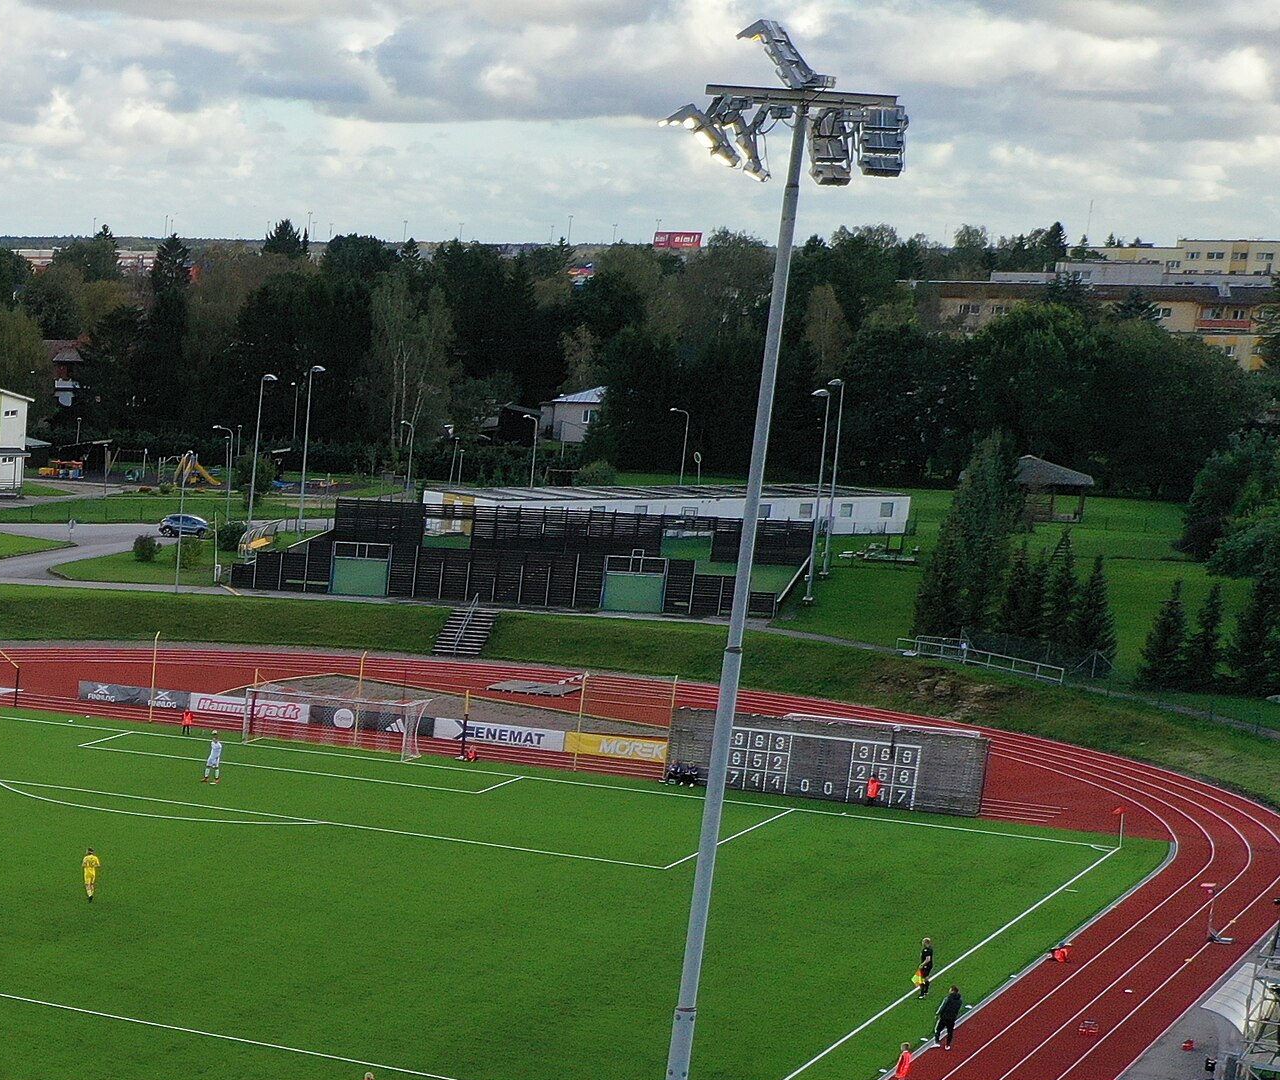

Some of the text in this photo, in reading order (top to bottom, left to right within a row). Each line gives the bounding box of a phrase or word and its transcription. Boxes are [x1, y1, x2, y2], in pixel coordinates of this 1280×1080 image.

[87, 693, 115, 702] FINNLOG
[734, 733, 784, 749] 9 6 3
[732, 752, 782, 769] 8 5 2
[859, 746, 912, 763] 3 6 9
[730, 771, 780, 789] 7 4 1
[856, 765, 909, 783] 2 5 8
[800, 779, 833, 795] 0 0
[854, 785, 864, 799] 1
[897, 790, 907, 803] 7
